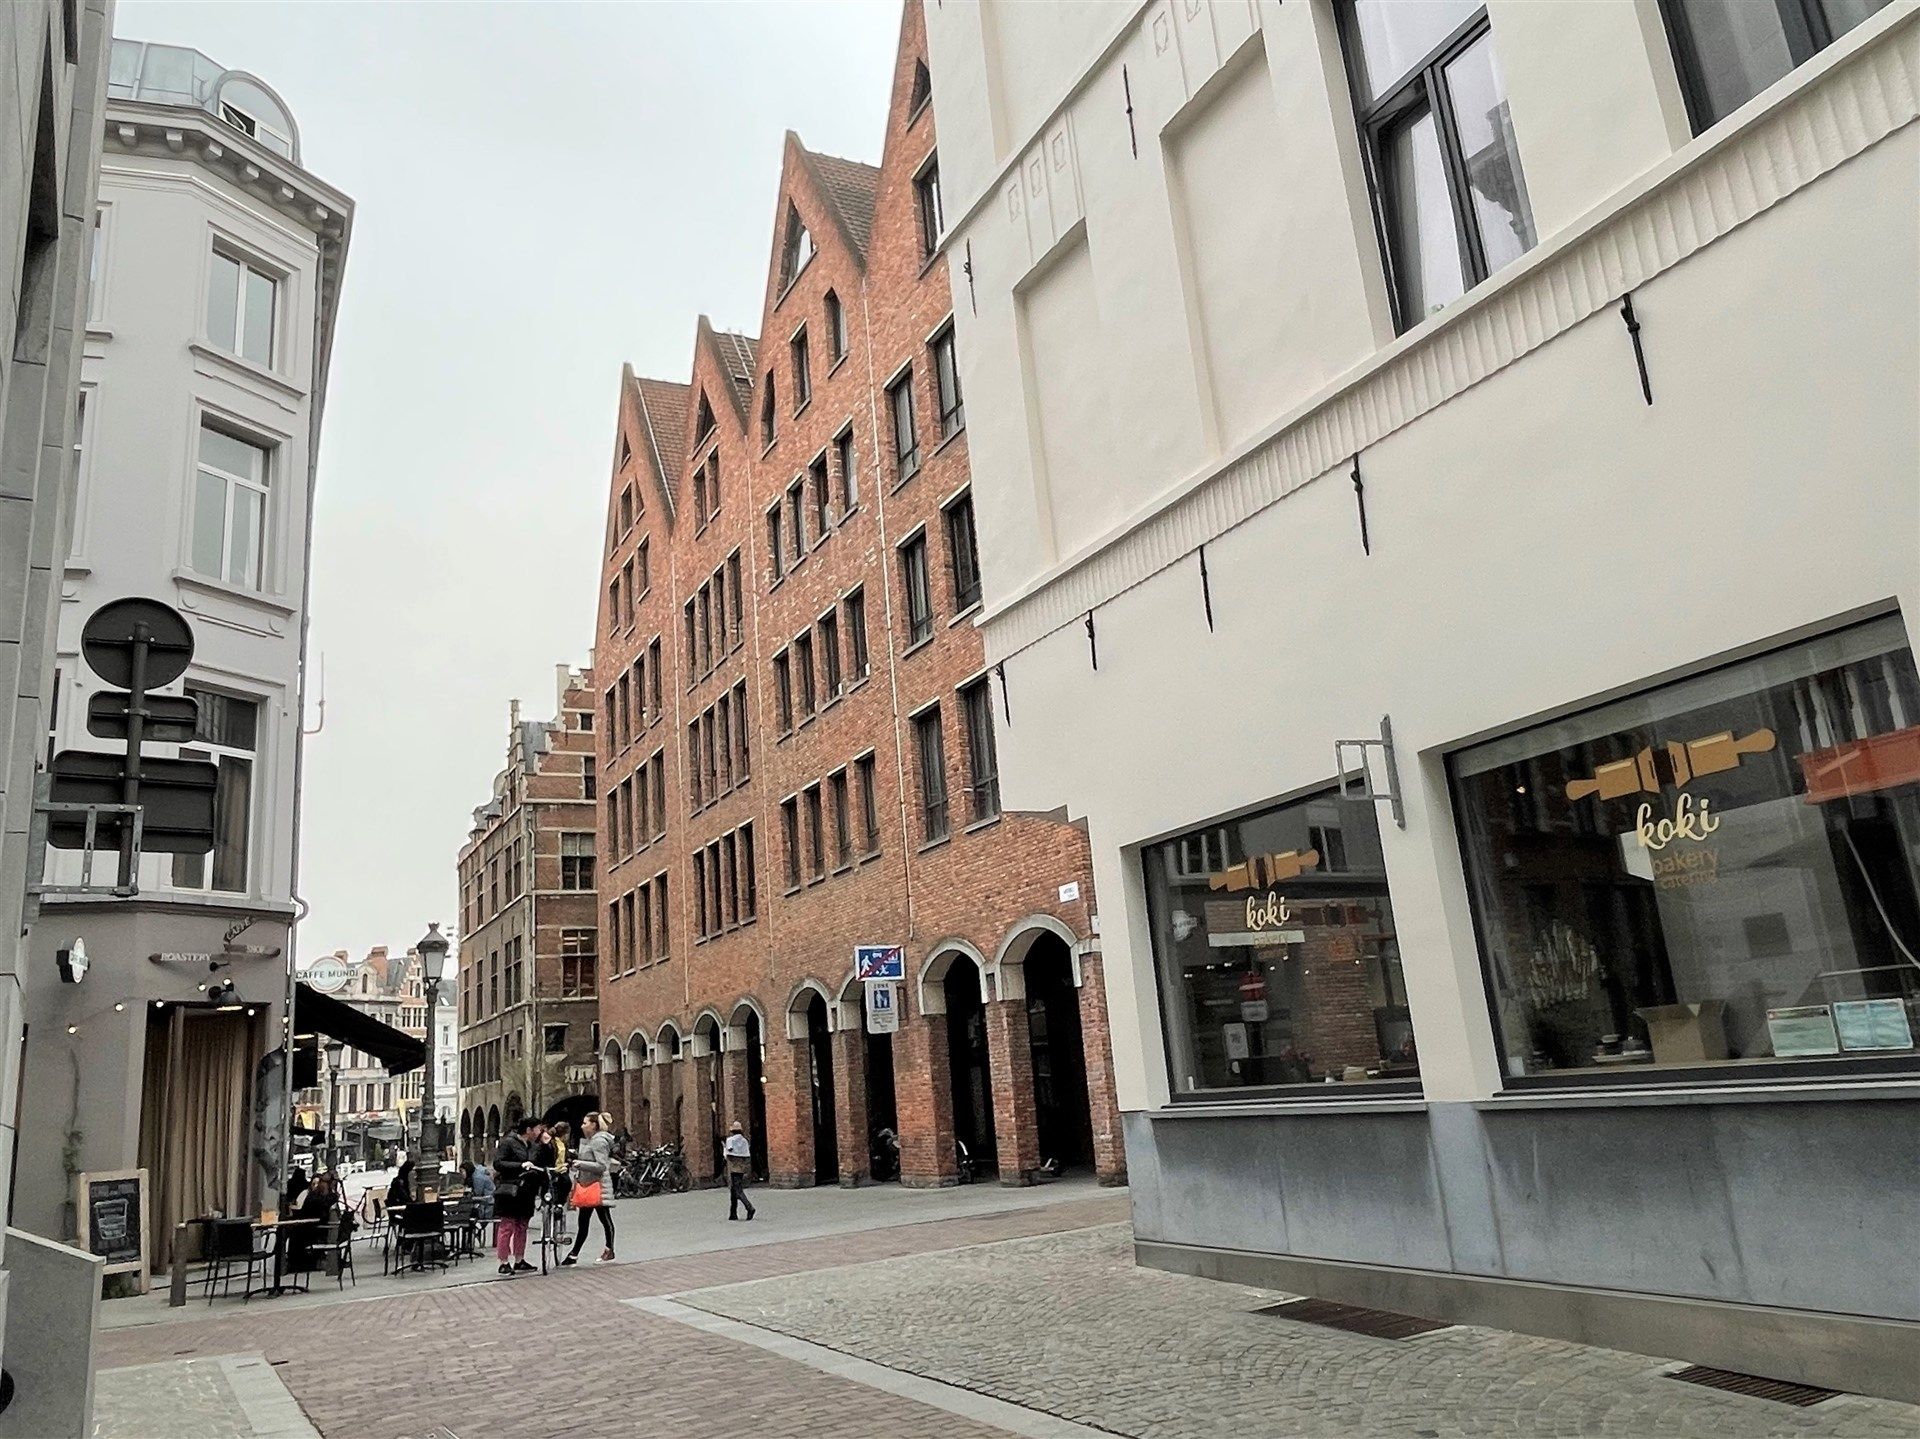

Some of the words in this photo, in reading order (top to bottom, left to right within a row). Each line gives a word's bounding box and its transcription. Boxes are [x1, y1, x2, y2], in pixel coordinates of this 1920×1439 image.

[1636, 792, 1720, 850] koki
[1246, 890, 1291, 931] koki
[160, 952, 212, 962] ROASTERY
[328, 969, 359, 978] MUNDI
